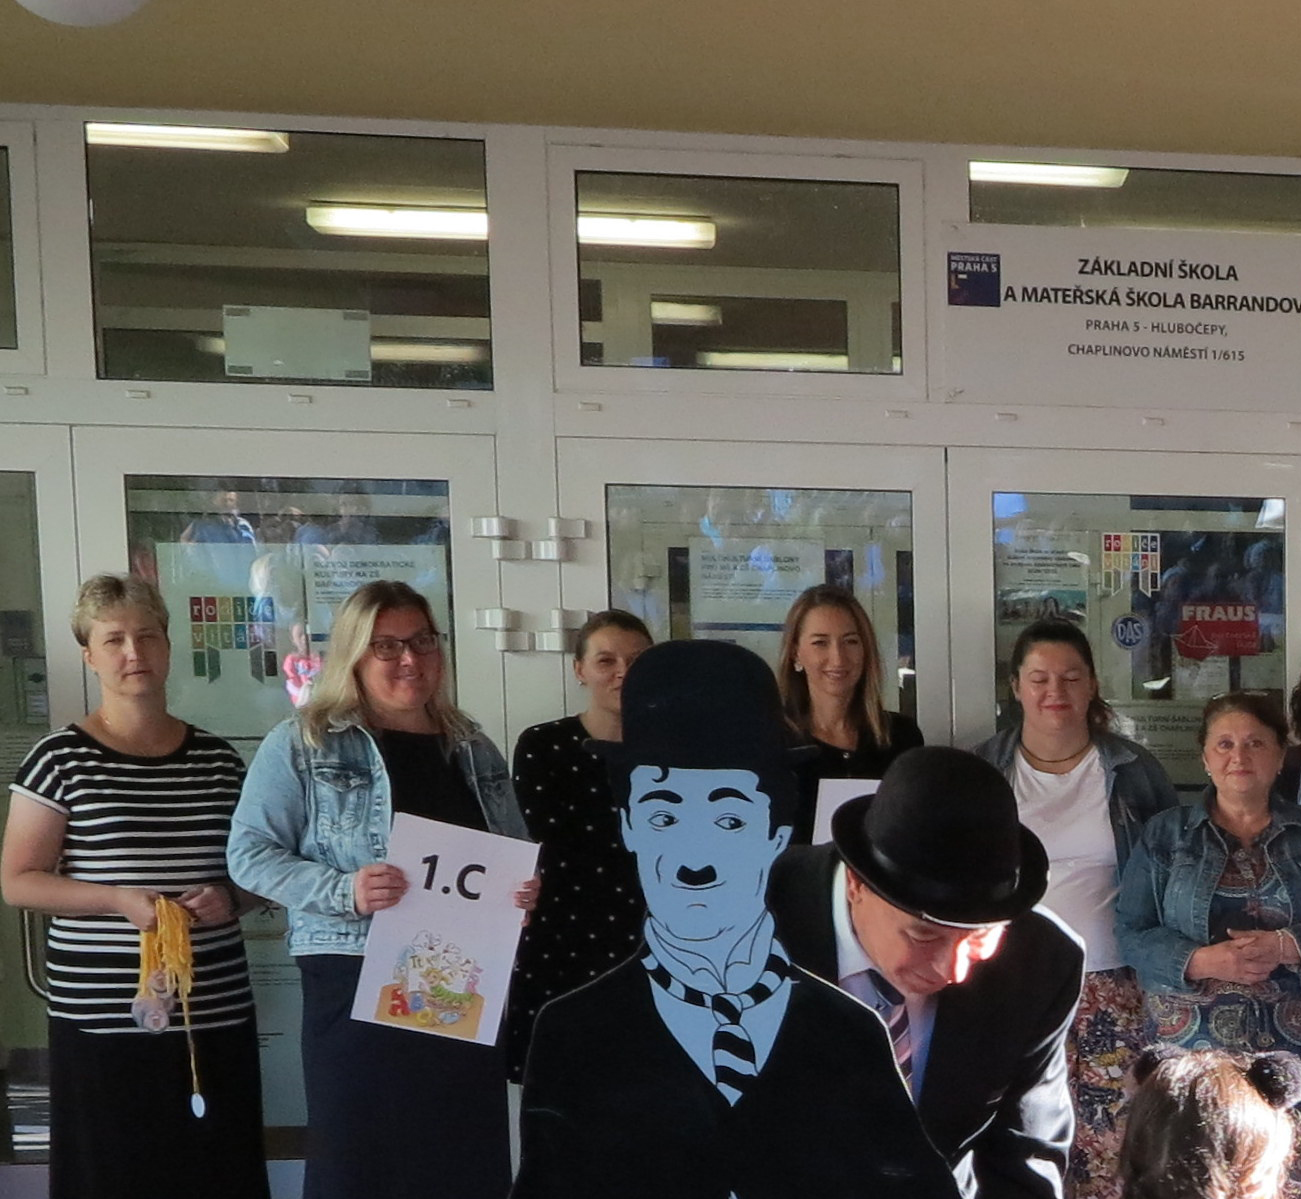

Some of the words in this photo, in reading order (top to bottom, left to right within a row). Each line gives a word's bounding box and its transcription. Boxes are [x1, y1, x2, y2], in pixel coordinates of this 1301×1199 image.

[950, 261, 989, 273] PRAHA
[991, 263, 998, 273] 5
[1078, 257, 1174, 279] ZÁKLADNÍ
[1178, 262, 1238, 282] ŠKOLA
[1003, 285, 1017, 302] A
[1021, 286, 1120, 307] MATEŘSKÁ
[1126, 289, 1185, 309] ŠKOLA
[1086, 319, 1129, 332] PRAHA
[1133, 321, 1141, 333] 5
[1151, 321, 1228, 337] HLUBOČEPY,
[1068, 343, 1150, 358] CHAPLINOVO
[1153, 345, 1208, 361] NÁMĚSTÍ
[1212, 349, 1245, 362] 1/615
[1182, 605, 1256, 621] FRAUS
[1117, 623, 1143, 642] DAS
[422, 854, 487, 900] 1.C
